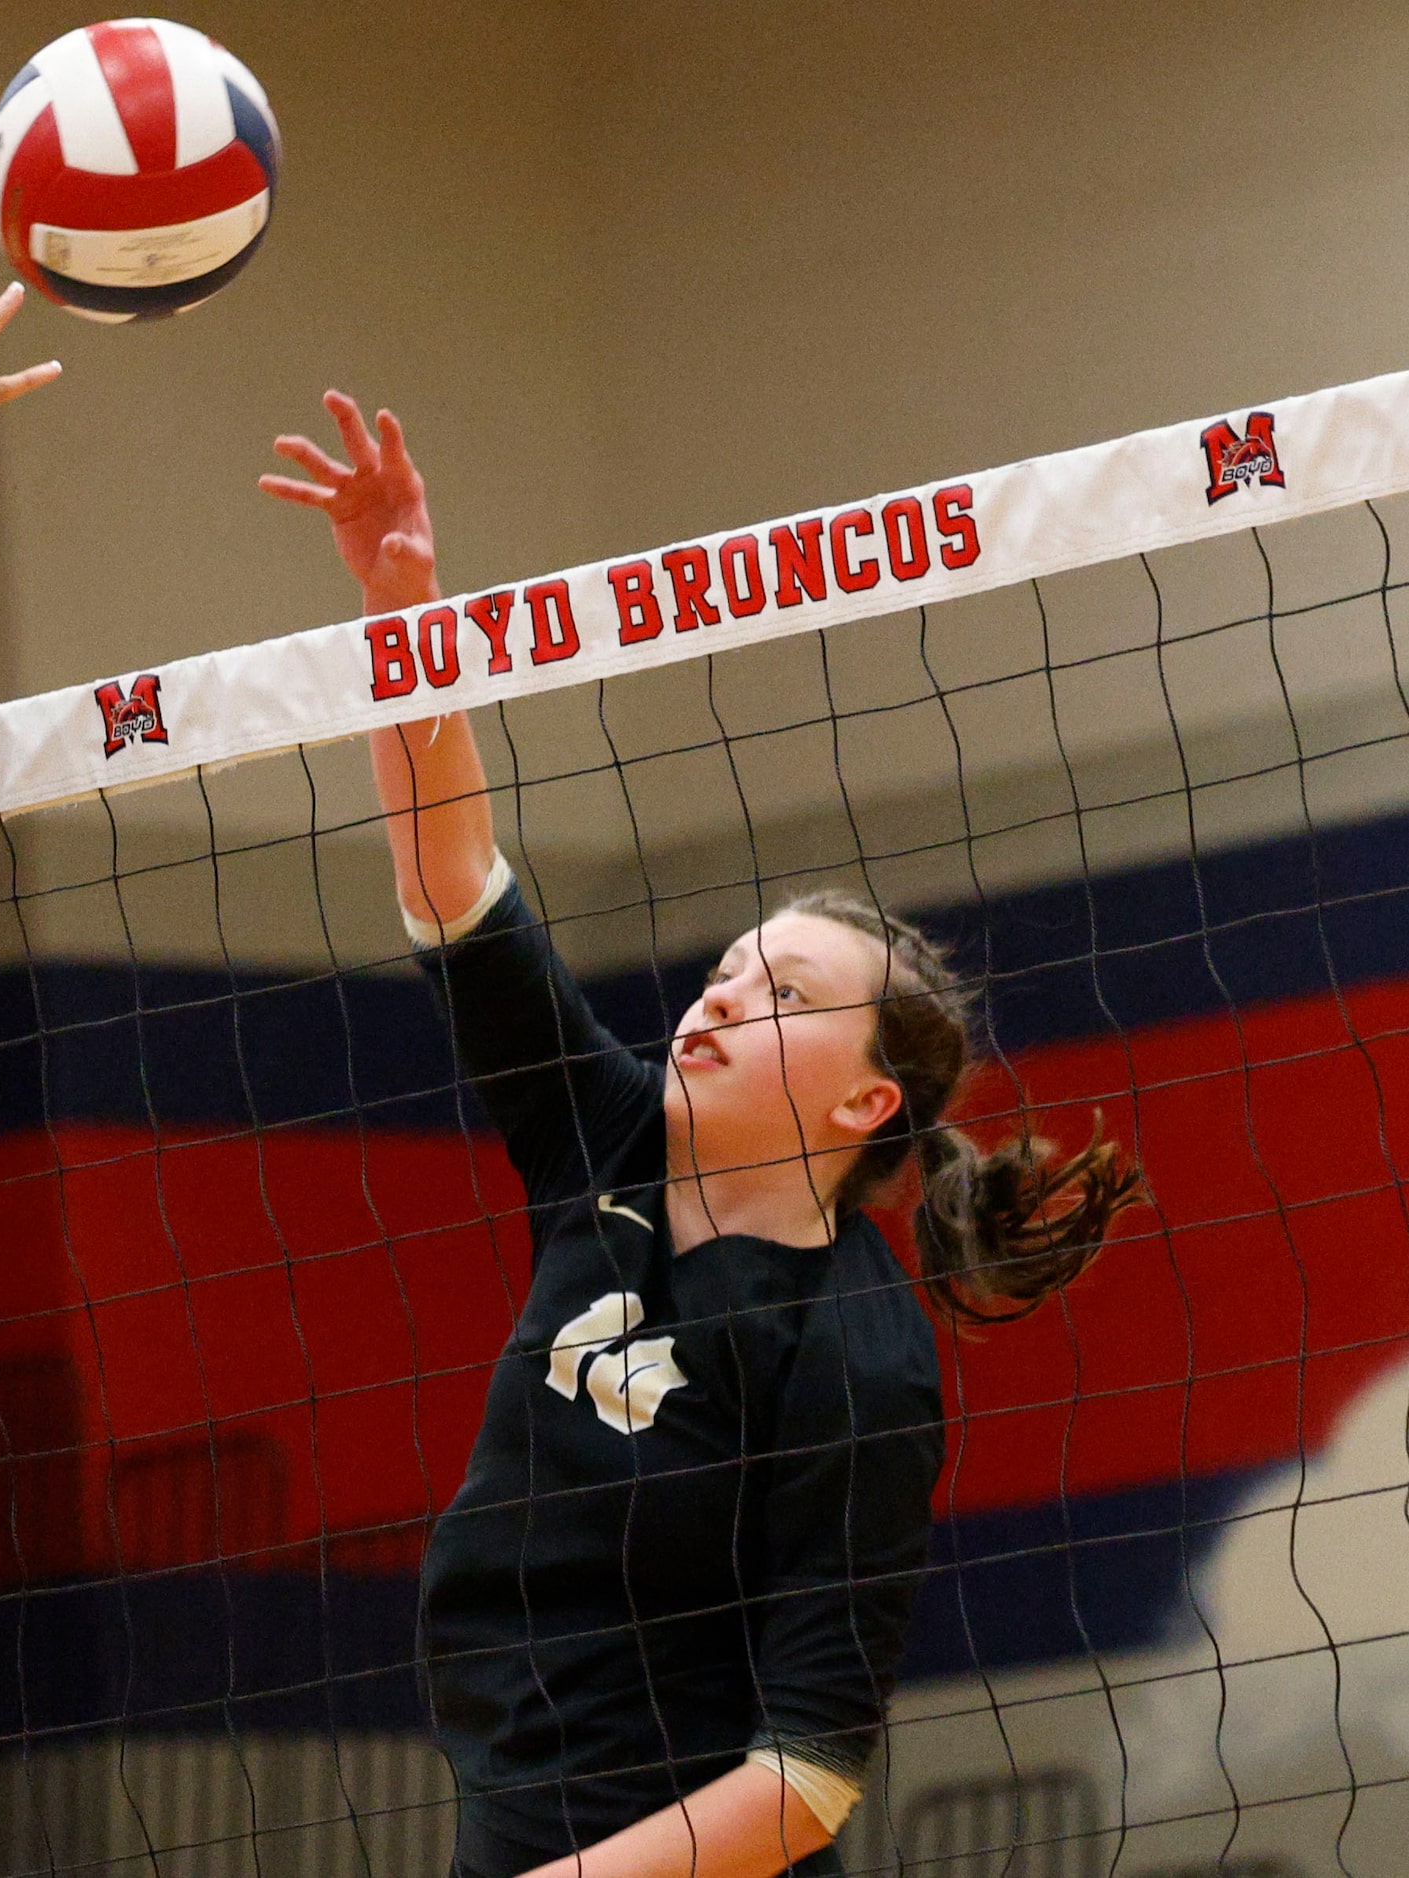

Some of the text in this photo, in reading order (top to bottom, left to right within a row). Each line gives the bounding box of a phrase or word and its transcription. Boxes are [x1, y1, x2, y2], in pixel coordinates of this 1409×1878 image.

[1200, 412, 1286, 507] M
[364, 484, 981, 702] BOYD BRONCOS
[94, 674, 169, 760] M
